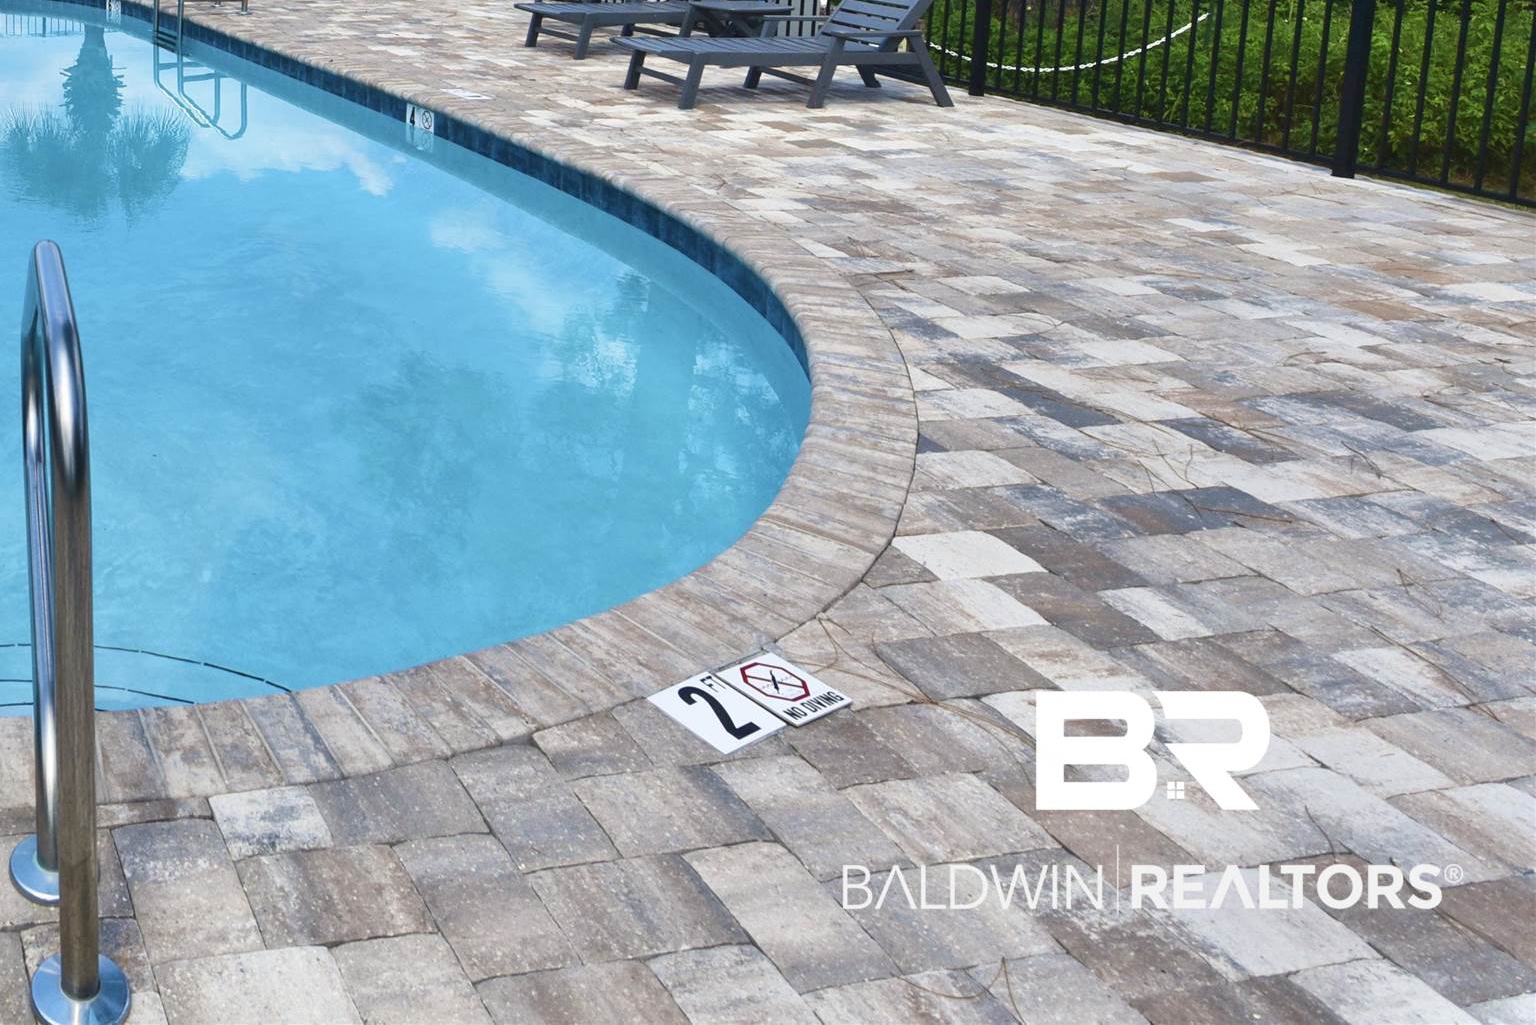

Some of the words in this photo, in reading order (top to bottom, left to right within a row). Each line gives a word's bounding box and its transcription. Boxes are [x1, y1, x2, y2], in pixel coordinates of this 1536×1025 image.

[700, 676, 726, 693] FT
[677, 686, 761, 740] 2
[783, 706, 808, 720] NO
[800, 691, 844, 713] DIVING
